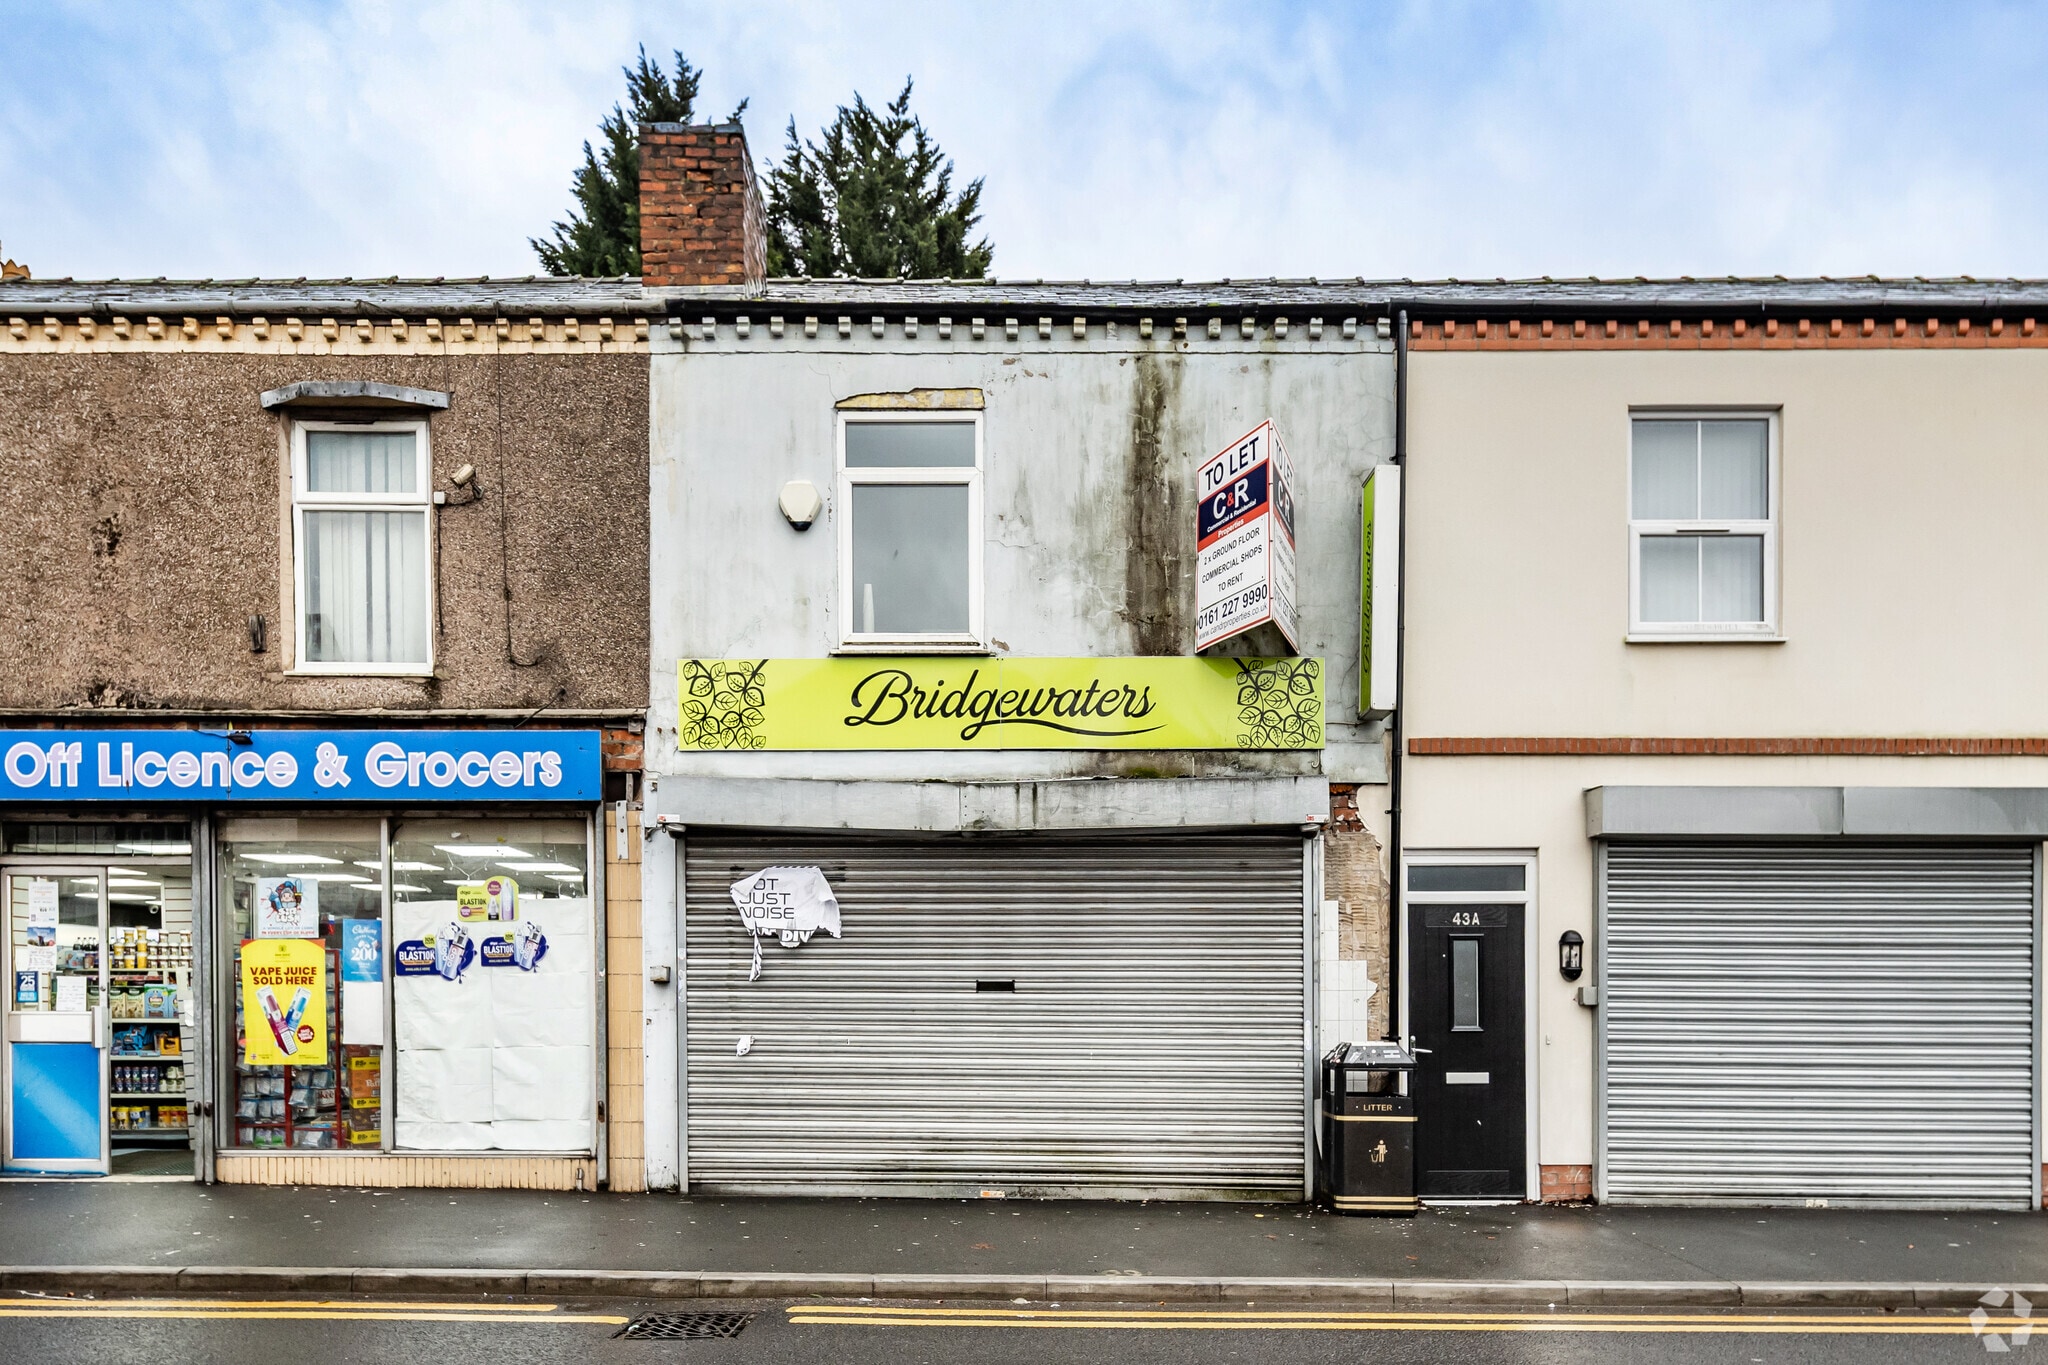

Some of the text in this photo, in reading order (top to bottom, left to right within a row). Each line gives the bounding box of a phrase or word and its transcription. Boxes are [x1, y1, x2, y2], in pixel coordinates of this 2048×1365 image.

[1205, 436, 1259, 490] TO LET
[1213, 478, 1249, 519] C&R
[1217, 518, 1244, 539] Properties
[1212, 540, 1237, 560] GROUND
[1238, 527, 1260, 546] FLOOR
[1201, 557, 1239, 584] COMMERCIAL
[1240, 544, 1263, 563] SHOPS
[1217, 572, 1244, 593] TO RENT
[1198, 606, 1219, 630] 0161
[1222, 597, 1240, 618] 227
[1242, 583, 1268, 608] 9990
[1198, 604, 1268, 640] www.candrproperties.co.uk
[844, 669, 1168, 741] Bridgewaters
[5, 742, 563, 788] Off Licence & Grocers
[753, 878, 779, 890] OT
[739, 893, 791, 905] JUST
[739, 906, 795, 919] NOISE
[1452, 912, 1480, 926] 43A
[351, 947, 378, 960] 200
[250, 967, 317, 975] VAPE JUICE
[253, 976, 314, 985] SOLD HERE
